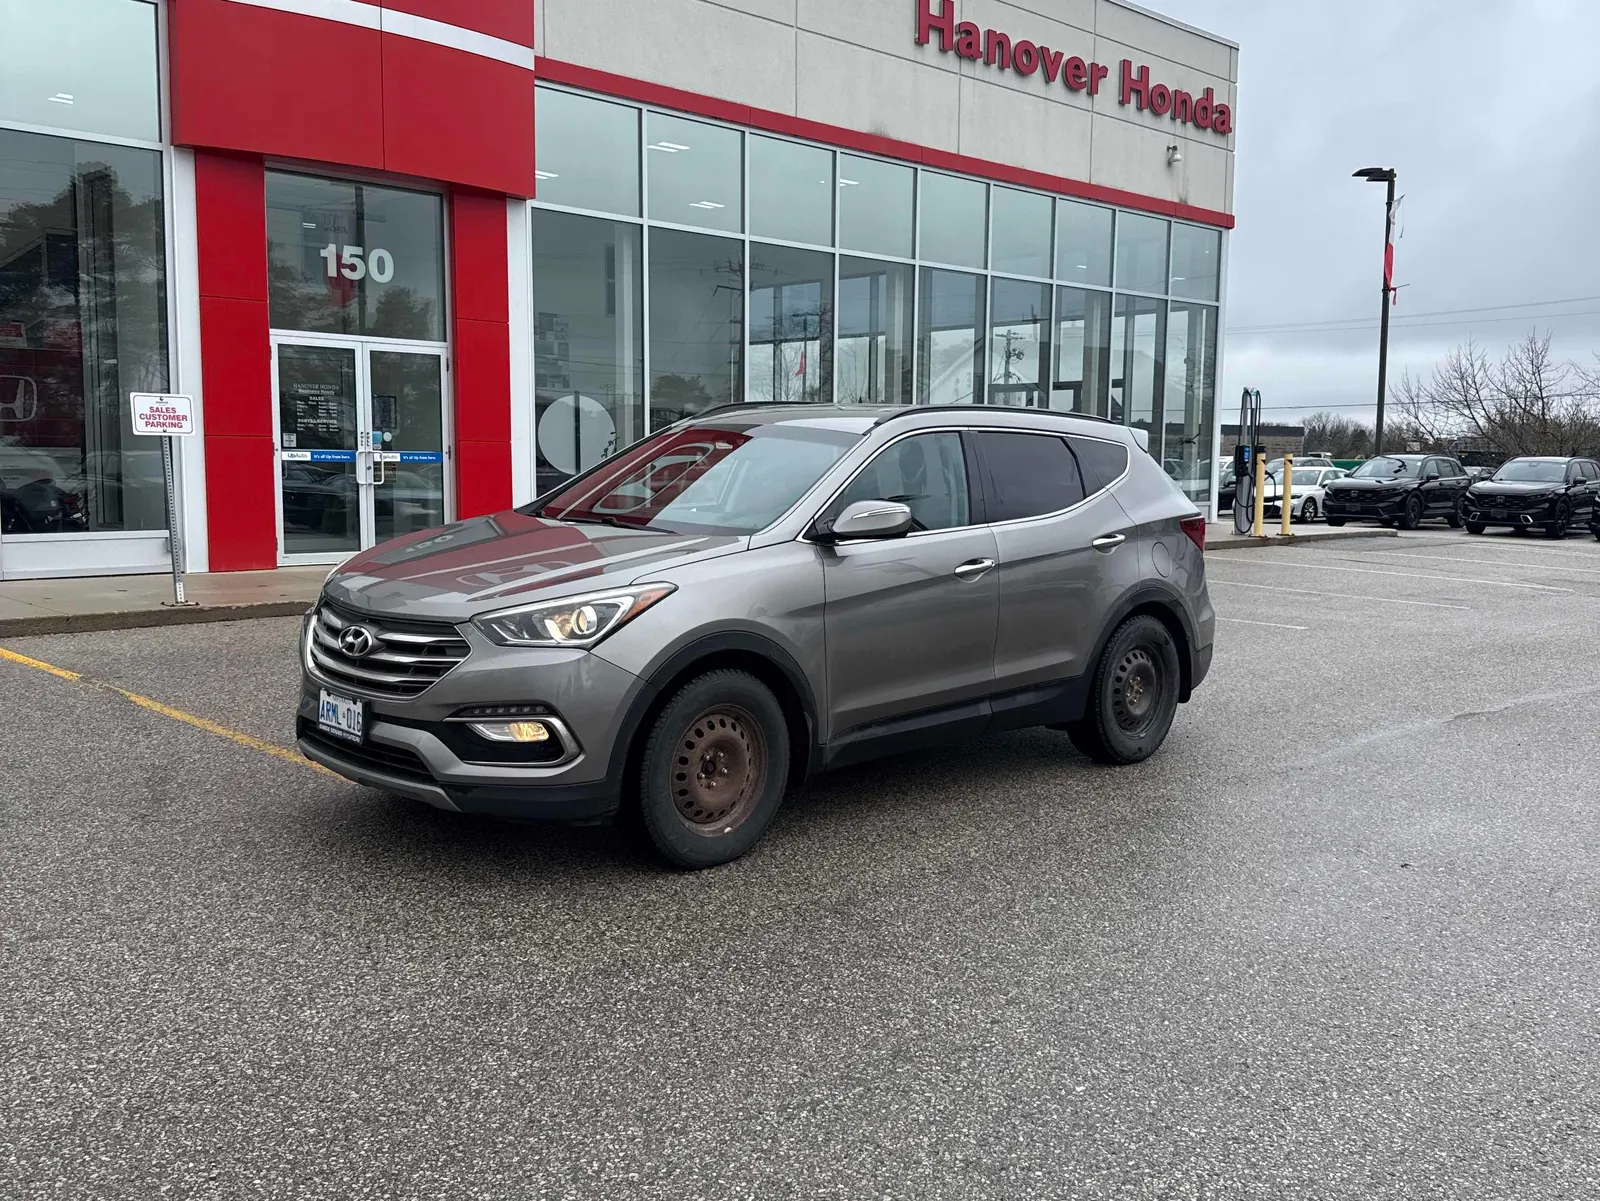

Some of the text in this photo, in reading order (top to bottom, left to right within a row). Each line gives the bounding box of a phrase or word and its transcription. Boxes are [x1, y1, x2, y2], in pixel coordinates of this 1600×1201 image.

[914, 0, 1232, 134] Hanover Honda
[320, 243, 394, 284] 150
[149, 406, 177, 414] SALES
[139, 413, 188, 421] CUSTOMER
[145, 421, 183, 429] PARKING
